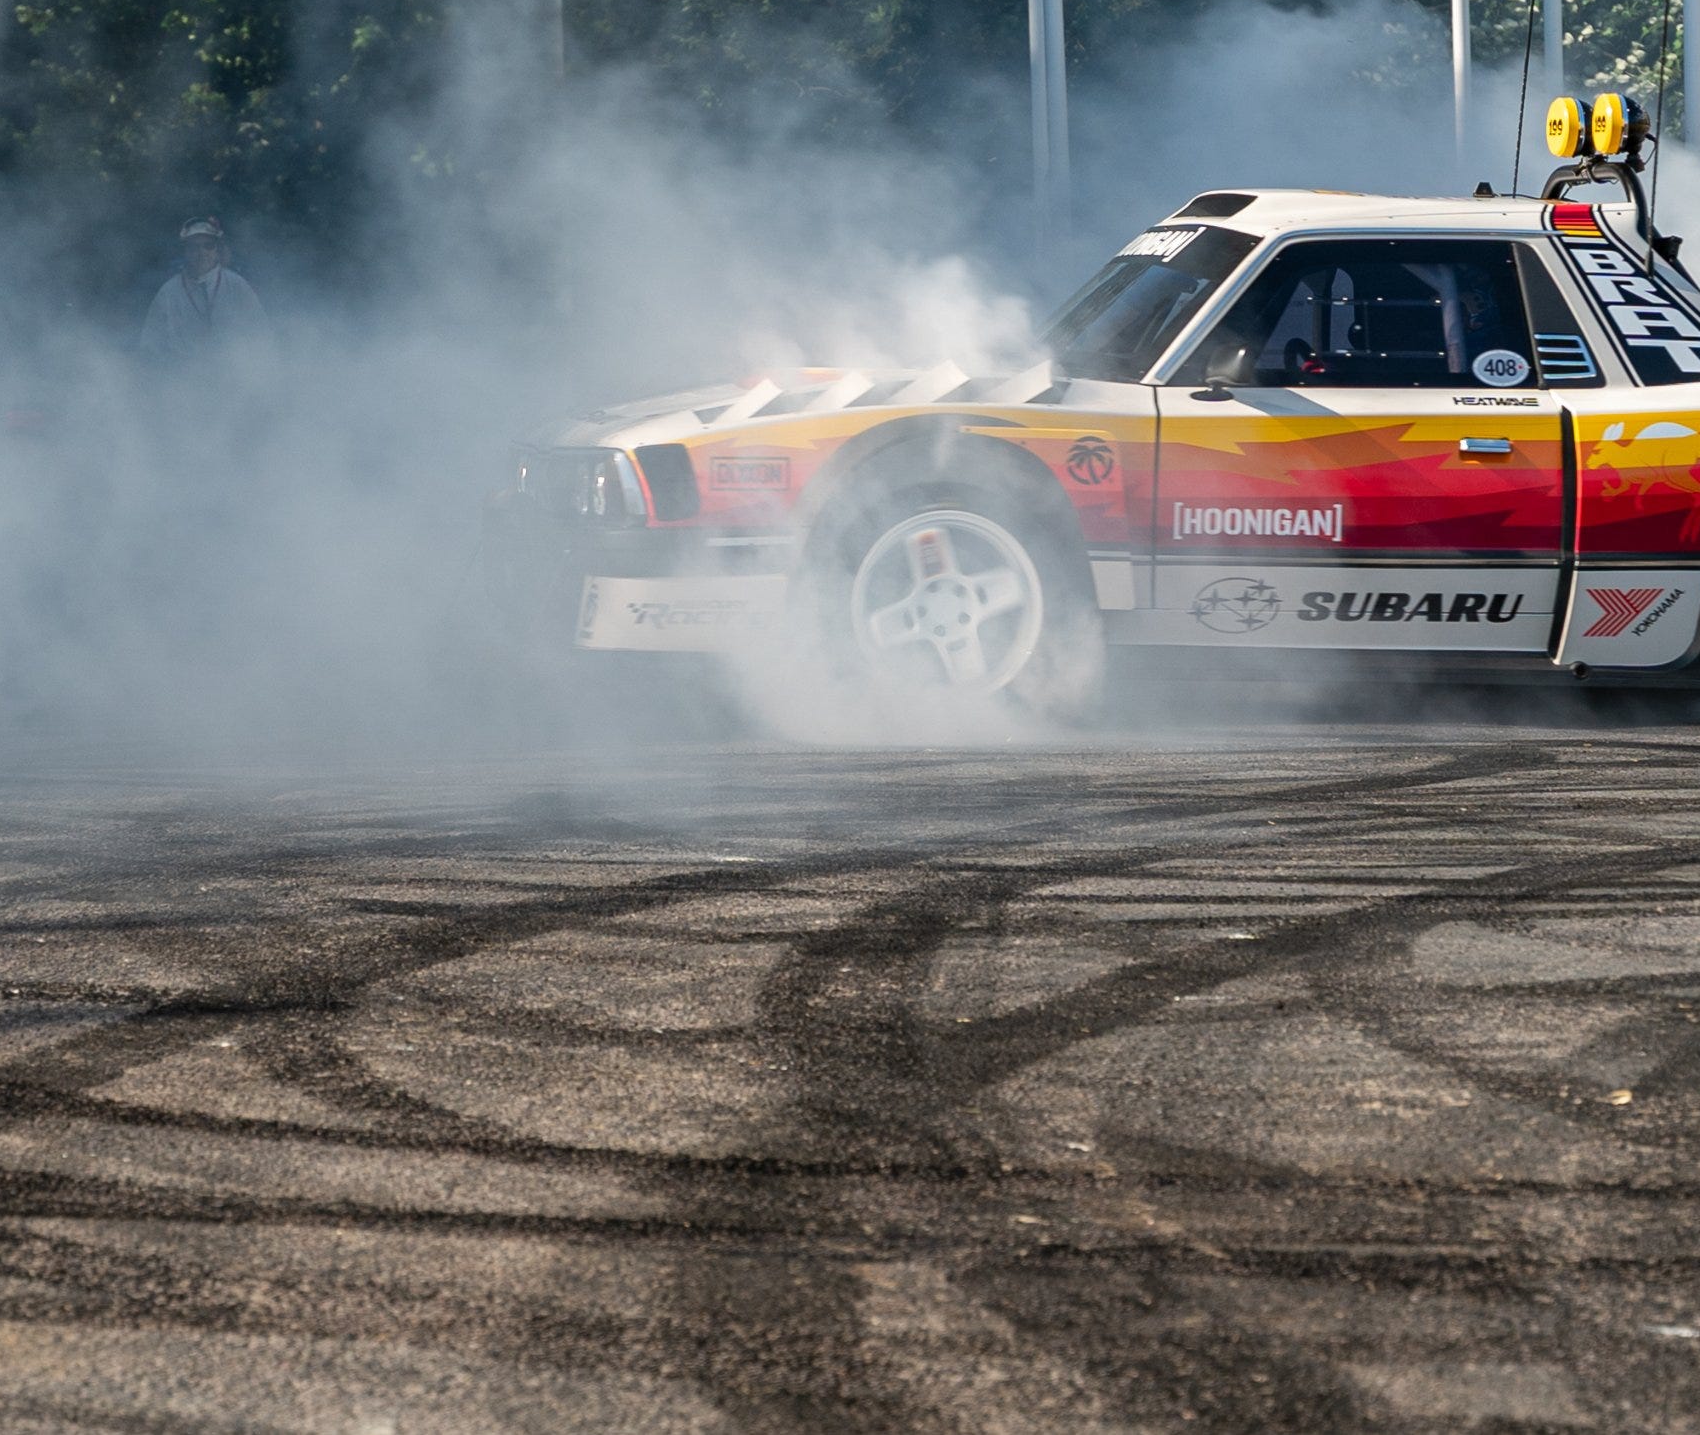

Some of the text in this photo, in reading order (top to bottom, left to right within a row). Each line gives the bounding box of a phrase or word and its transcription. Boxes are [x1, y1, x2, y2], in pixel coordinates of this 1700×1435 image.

[1483, 359, 1517, 376] 408
[1452, 397, 1540, 407] HEATWAVE
[1172, 502, 1342, 542] [HOONIGAN]
[1297, 591, 1525, 623] SUBARU
[1631, 588, 1685, 637] YOKOHAMA
